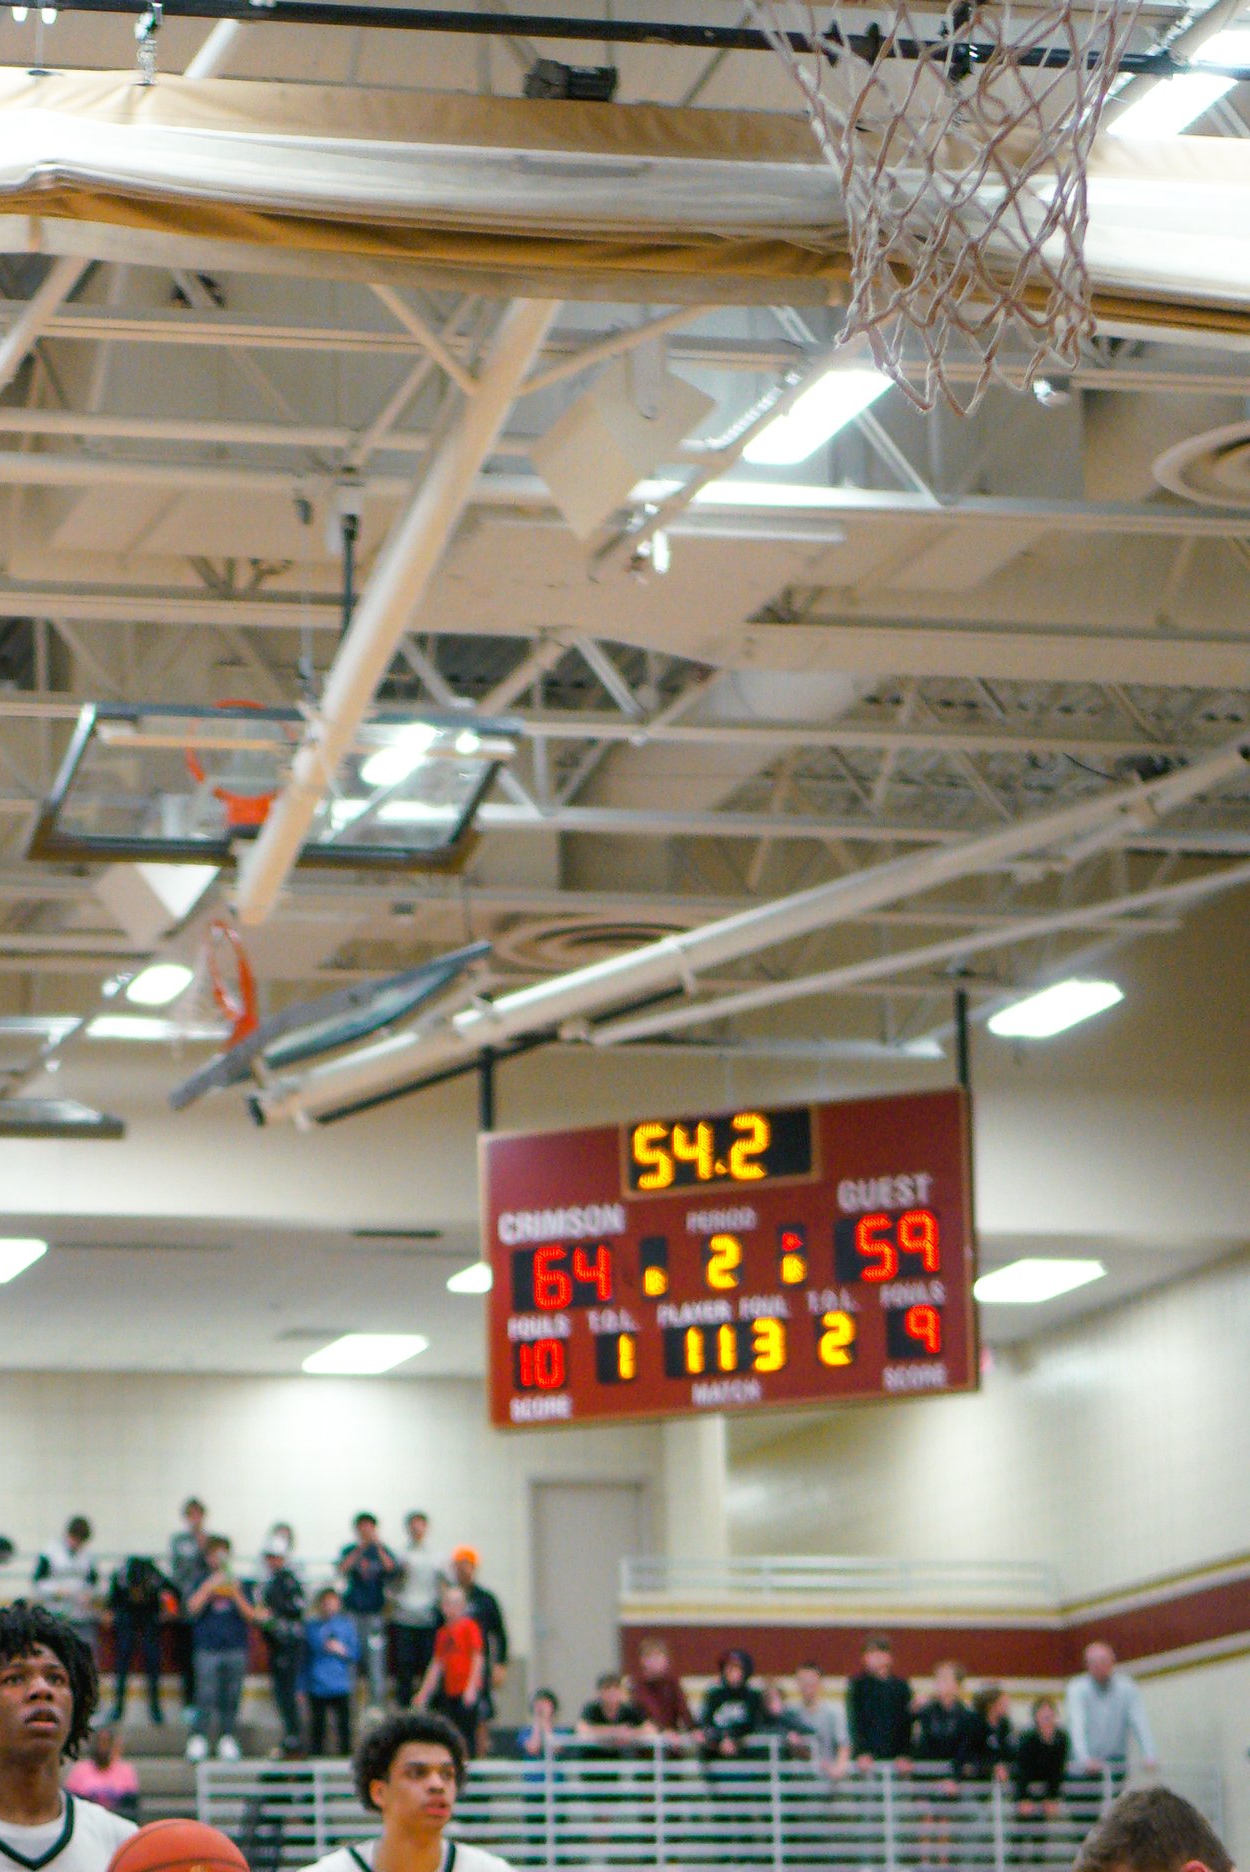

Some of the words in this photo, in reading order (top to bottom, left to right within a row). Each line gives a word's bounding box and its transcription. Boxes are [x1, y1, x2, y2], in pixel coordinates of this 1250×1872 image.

[632, 1111, 771, 1190] 54.2
[837, 1173, 933, 1213] GUEST
[498, 1204, 625, 1245] CRIMSON
[855, 1209, 941, 1282] 59
[533, 1244, 613, 1310] 64
[706, 1233, 742, 1290] 2
[817, 1310, 856, 1367] 2
[904, 1304, 941, 1354] 9
[519, 1338, 565, 1389] 10
[618, 1333, 636, 1380] 1
